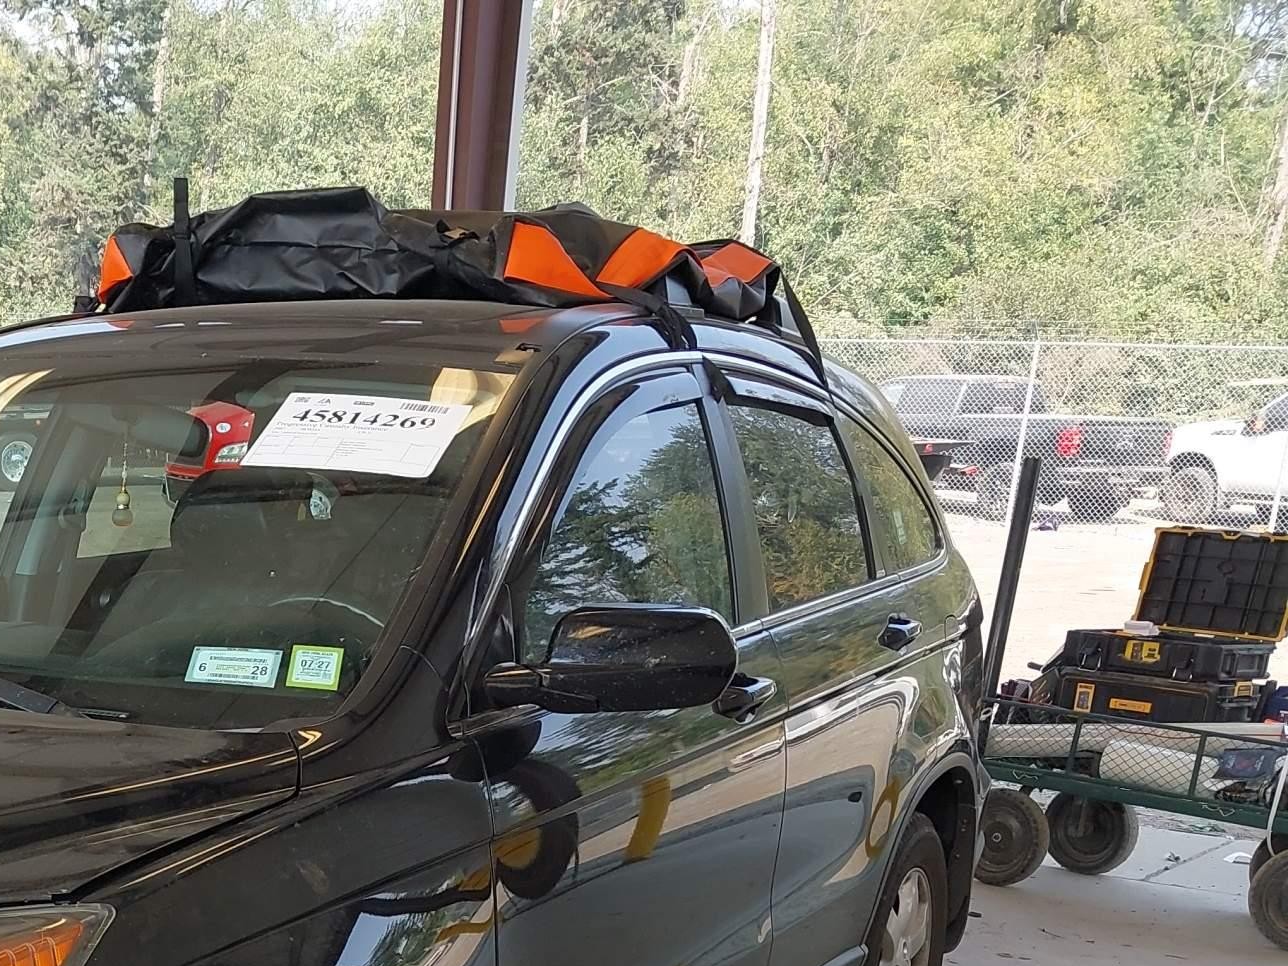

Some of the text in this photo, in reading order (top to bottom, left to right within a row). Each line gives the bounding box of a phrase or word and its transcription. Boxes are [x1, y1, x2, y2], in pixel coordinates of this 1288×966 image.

[293, 408, 436, 430] 45814269
[198, 662, 208, 672] 6
[250, 665, 269, 676] 28
